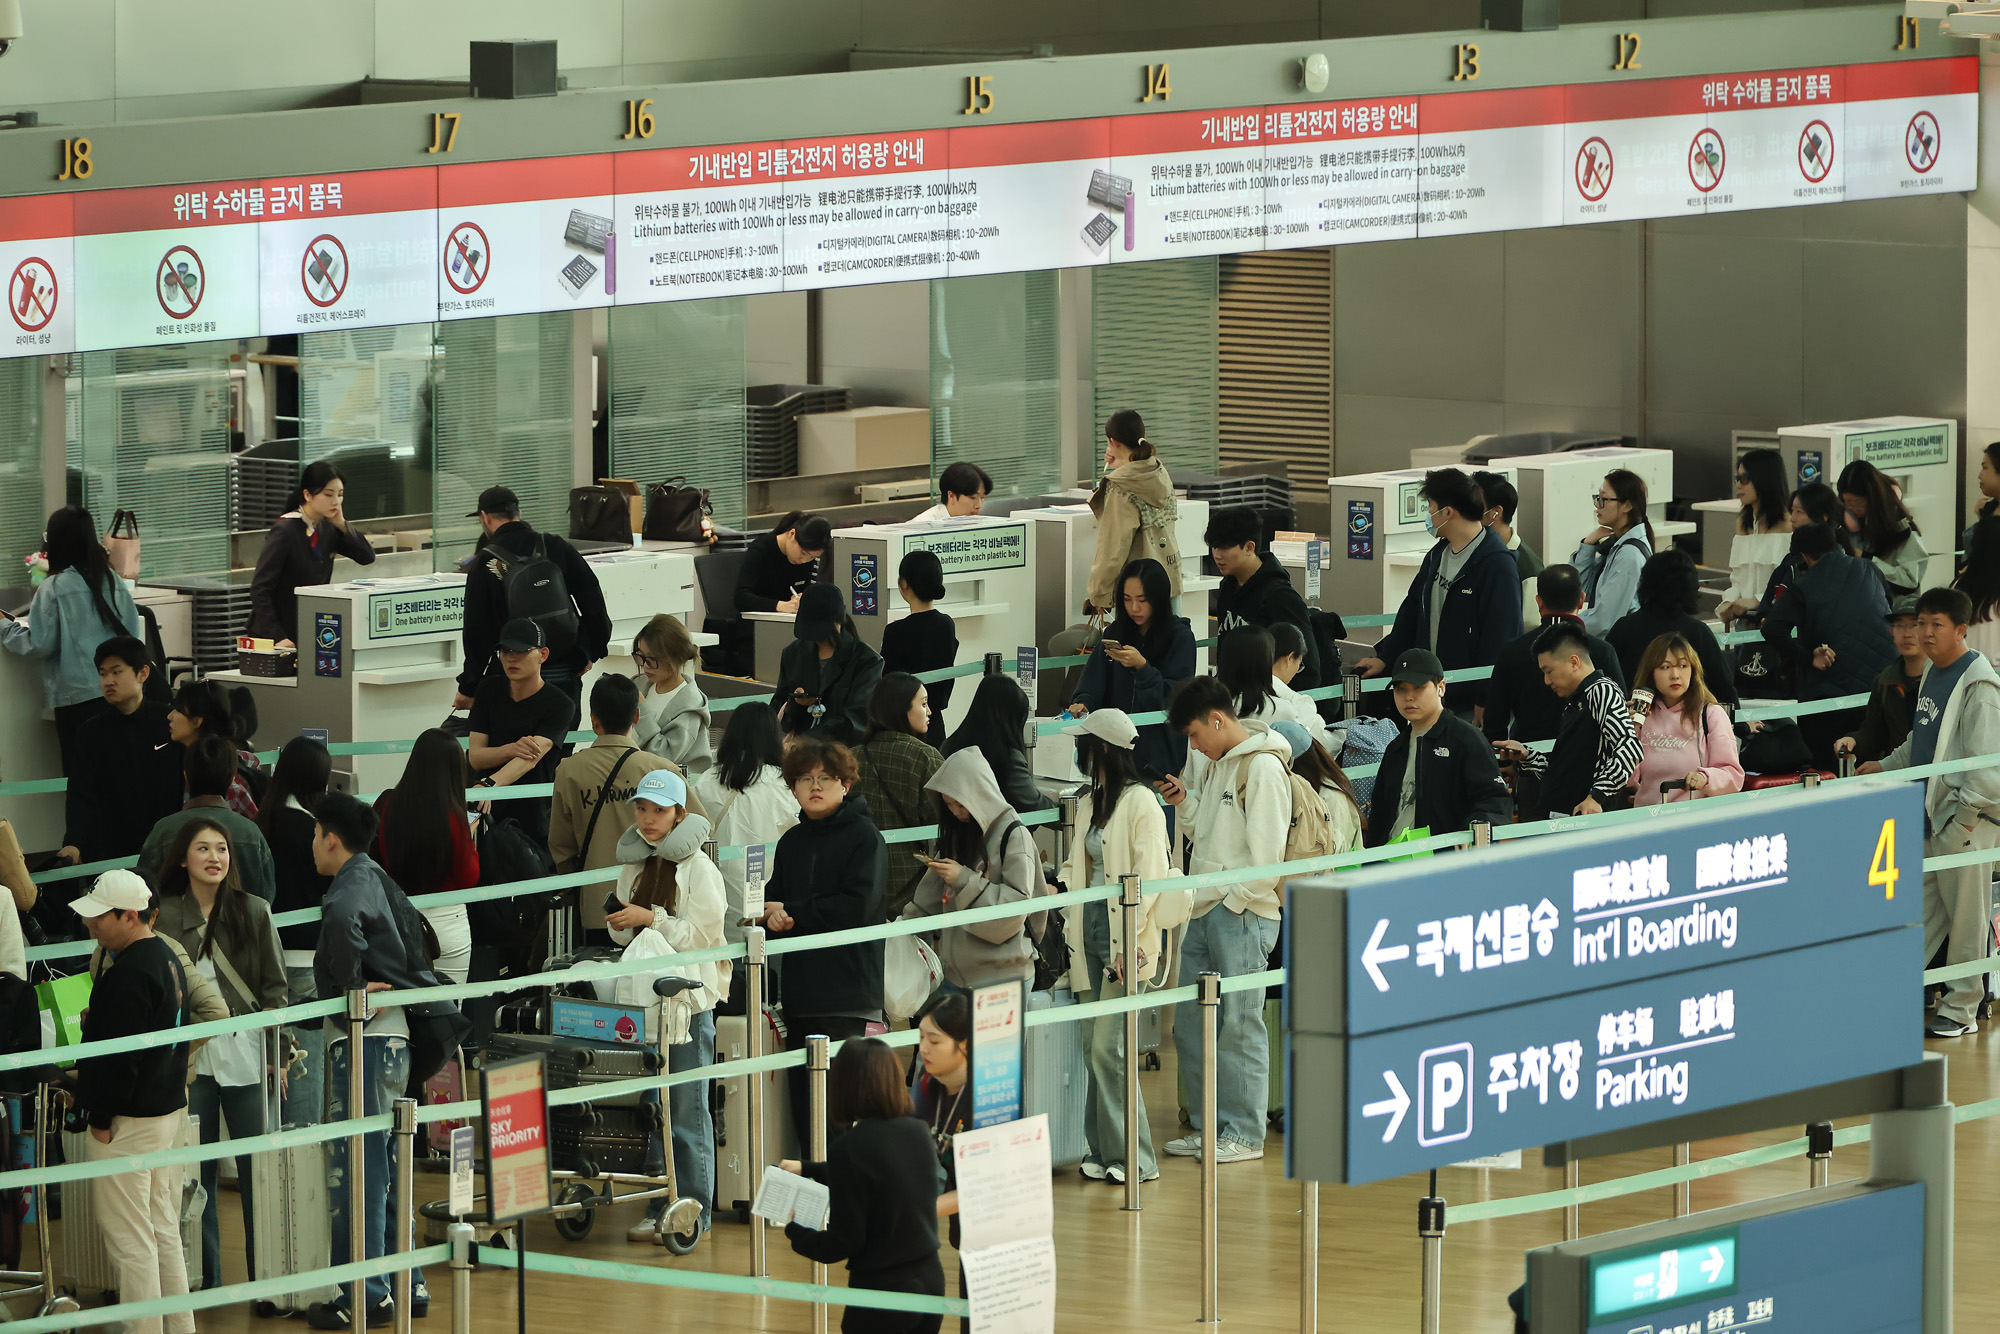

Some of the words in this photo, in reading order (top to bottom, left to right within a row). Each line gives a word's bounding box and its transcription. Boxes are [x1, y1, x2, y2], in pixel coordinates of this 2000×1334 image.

[1614, 32, 1642, 70] J2
[1897, 15, 1920, 50] J1
[1452, 43, 1480, 81] J3
[963, 76, 994, 115] J5
[1143, 63, 1172, 103] J4
[1702, 81, 1730, 107] 위탁
[1732, 77, 1772, 105] 수하물
[1775, 75, 1802, 102] 금지
[1805, 73, 1832, 99] 품목
[427, 112, 461, 154] J7
[622, 99, 656, 139] J6
[1201, 113, 1260, 144] 기내반입
[1264, 108, 1337, 139] 리튬건전지
[1341, 104, 1385, 133] 허용량
[1388, 102, 1418, 130] 안내
[58, 137, 94, 181] J8
[688, 150, 752, 181] 기내반입
[757, 144, 837, 177] 리튬건전지
[841, 140, 889, 170] 허용량
[893, 137, 924, 166] 안내
[1151, 163, 1193, 181] 위탁수하물
[1195, 162, 1213, 177] 불가,
[1215, 160, 1245, 175] 100Wh
[1246, 158, 1263, 173] 이내
[1264, 154, 1313, 171] 기내반입가능
[1150, 181, 1185, 197] Lithium
[1186, 178, 1226, 194] batteries
[1227, 177, 1248, 191] with
[1249, 175, 1279, 189] 100Wh
[1280, 175, 1290, 187] or
[1292, 173, 1309, 186] less
[1311, 173, 1330, 187] may
[1331, 169, 1343, 183] be
[1344, 167, 1379, 181] allowed
[1380, 166, 1389, 179] in
[1390, 165, 1428, 180] carry-on
[1430, 161, 1466, 178] baggage
[173, 191, 208, 221] 위탁
[212, 187, 266, 219] 수하물
[269, 184, 304, 214] 금지
[308, 182, 343, 211] 품목
[634, 202, 680, 221] 위탁수하물
[682, 201, 702, 217] 불가,
[704, 198, 737, 214] 100Wh
[739, 196, 756, 213] 이내
[758, 192, 812, 211] 기내반입가능
[926, 180, 977, 198] 100Wh以内
[634, 222, 672, 239] Lithium
[673, 219, 717, 235] batteries
[718, 216, 740, 232] with
[742, 214, 774, 229] 100Wh
[776, 216, 787, 228] or
[788, 212, 807, 227] less
[809, 212, 829, 228] may
[831, 208, 844, 223] be
[845, 206, 883, 222] allowed
[884, 205, 894, 219] in
[895, 203, 936, 220] carry-on
[937, 199, 978, 217] baggage
[748, 243, 779, 257] 3~10Wh
[966, 226, 1000, 239] 10~20Wh
[946, 249, 980, 263] 20~40Wh
[1876, 452, 1897, 462] battery
[1902, 450, 1915, 459] each
[1915, 448, 1933, 459] plastic
[927, 540, 971, 554] 보조배터리는
[972, 538, 988, 550] 각각
[940, 553, 963, 565] battery
[964, 552, 971, 562] in
[971, 551, 986, 561] each
[986, 549, 1008, 562] plastic
[1008, 549, 1020, 560] bag
[395, 598, 442, 615] 보조배터리는
[443, 596, 460, 610] 각각
[395, 616, 408, 627] One
[408, 614, 434, 625] battery
[434, 612, 441, 622] in
[442, 610, 458, 621] each
[1867, 817, 1900, 900] 4
[1415, 897, 1560, 978] 국제선탑승
[1627, 901, 1738, 958] Boarding
[1486, 1039, 1583, 1114] 주차장
[1596, 1056, 1689, 1111] Parking
[1431, 1060, 1464, 1132] P
[490, 1118, 512, 1135] SKY
[491, 1126, 541, 1149] PRIORITY
